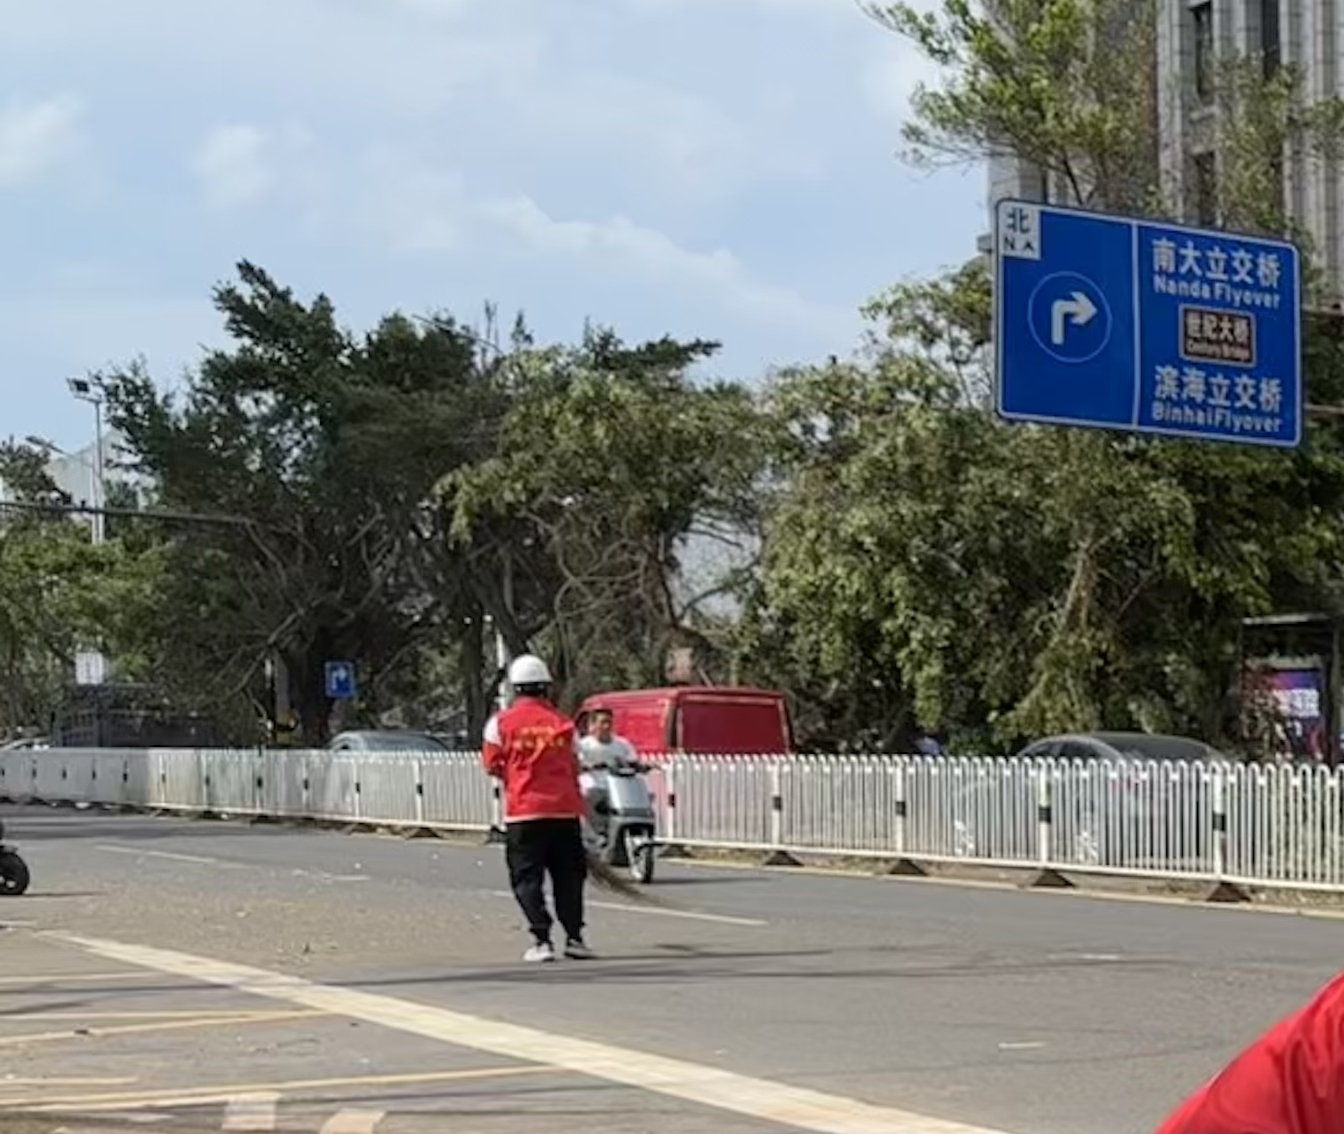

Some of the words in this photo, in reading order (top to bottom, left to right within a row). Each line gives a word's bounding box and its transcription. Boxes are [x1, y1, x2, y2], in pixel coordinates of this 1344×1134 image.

[1004, 207, 1030, 234] 北
[1152, 237, 1281, 288] 南大立交桥
[1153, 275, 1211, 299] Nanda
[1214, 282, 1281, 309] Flyover
[1154, 365, 1282, 413] 滨海立交桥
